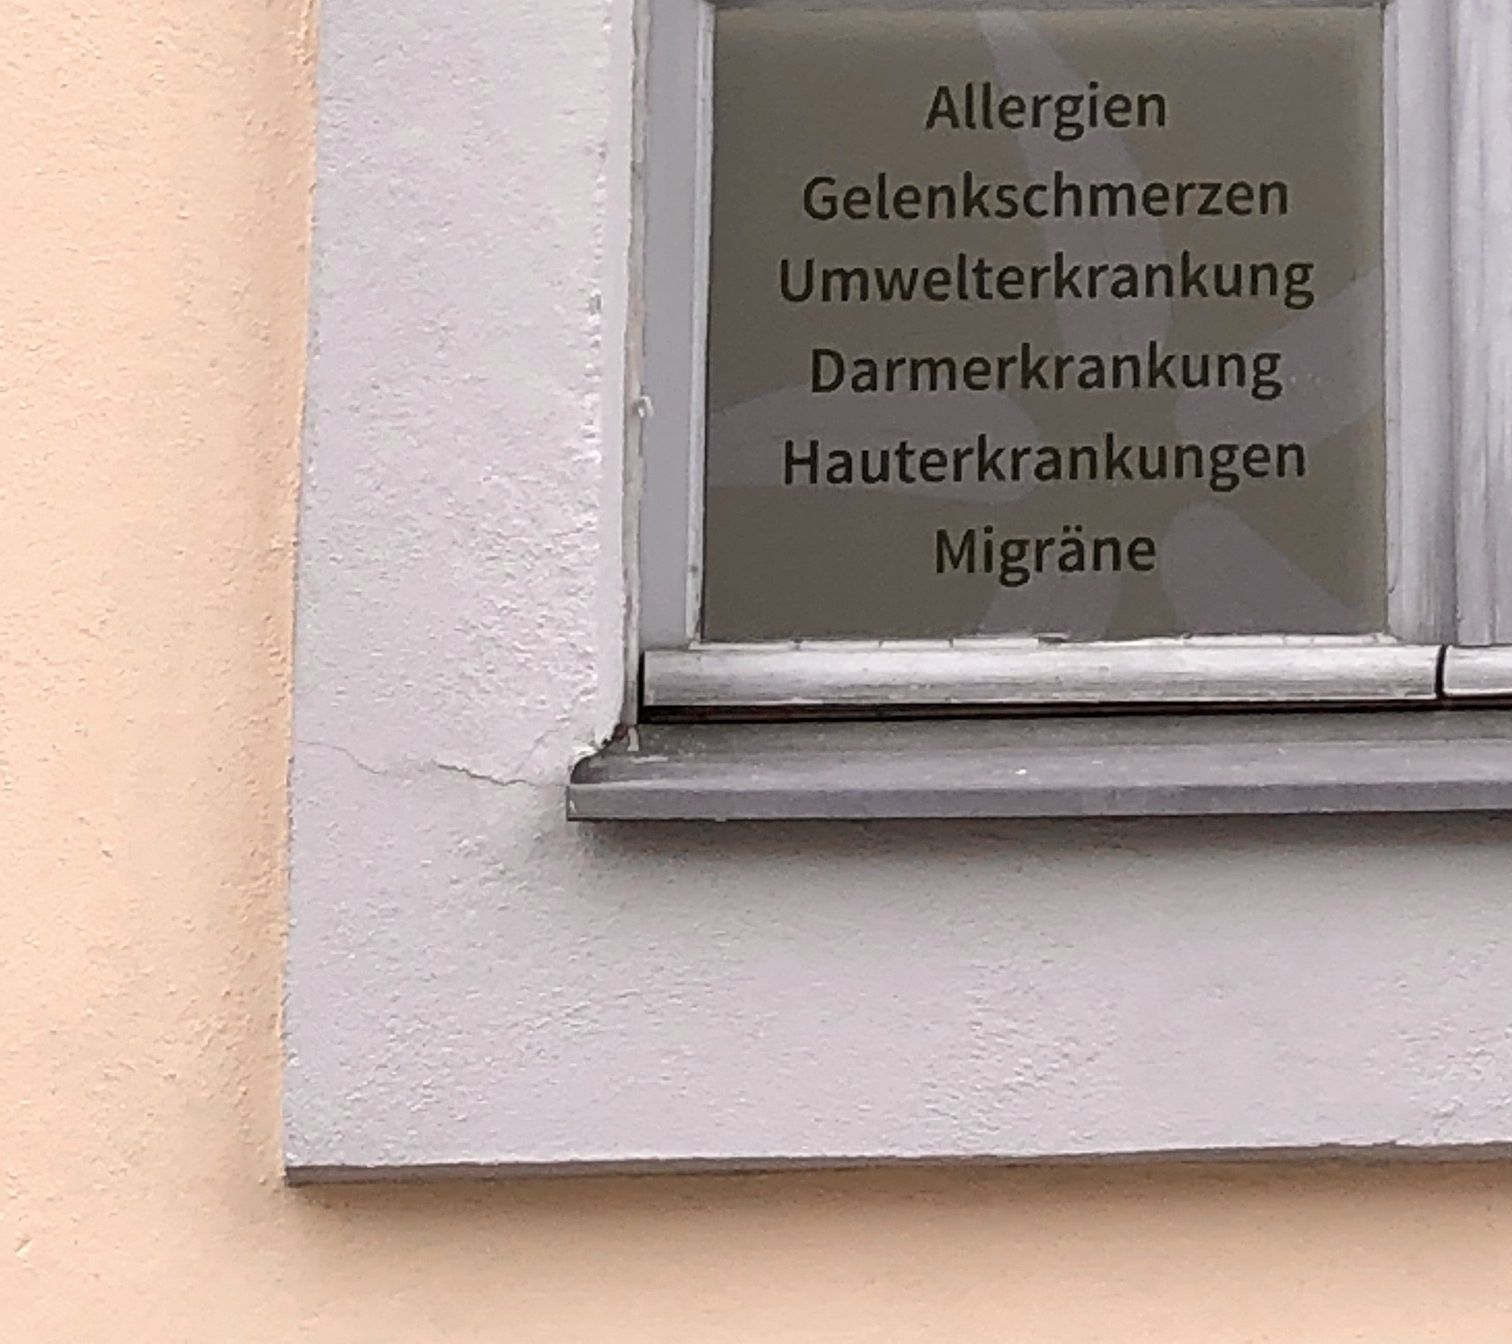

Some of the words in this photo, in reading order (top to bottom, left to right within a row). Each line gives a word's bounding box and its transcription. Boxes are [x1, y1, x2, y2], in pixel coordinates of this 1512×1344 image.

[925, 81, 1167, 142] Allergien
[802, 170, 1289, 221] Gelenkschmerzen
[779, 250, 1315, 310] Umwelterkrankung
[810, 341, 1283, 400] Darmerkrankung
[783, 433, 1306, 492] Hauterkrankungen
[935, 525, 1156, 587] Migräne
